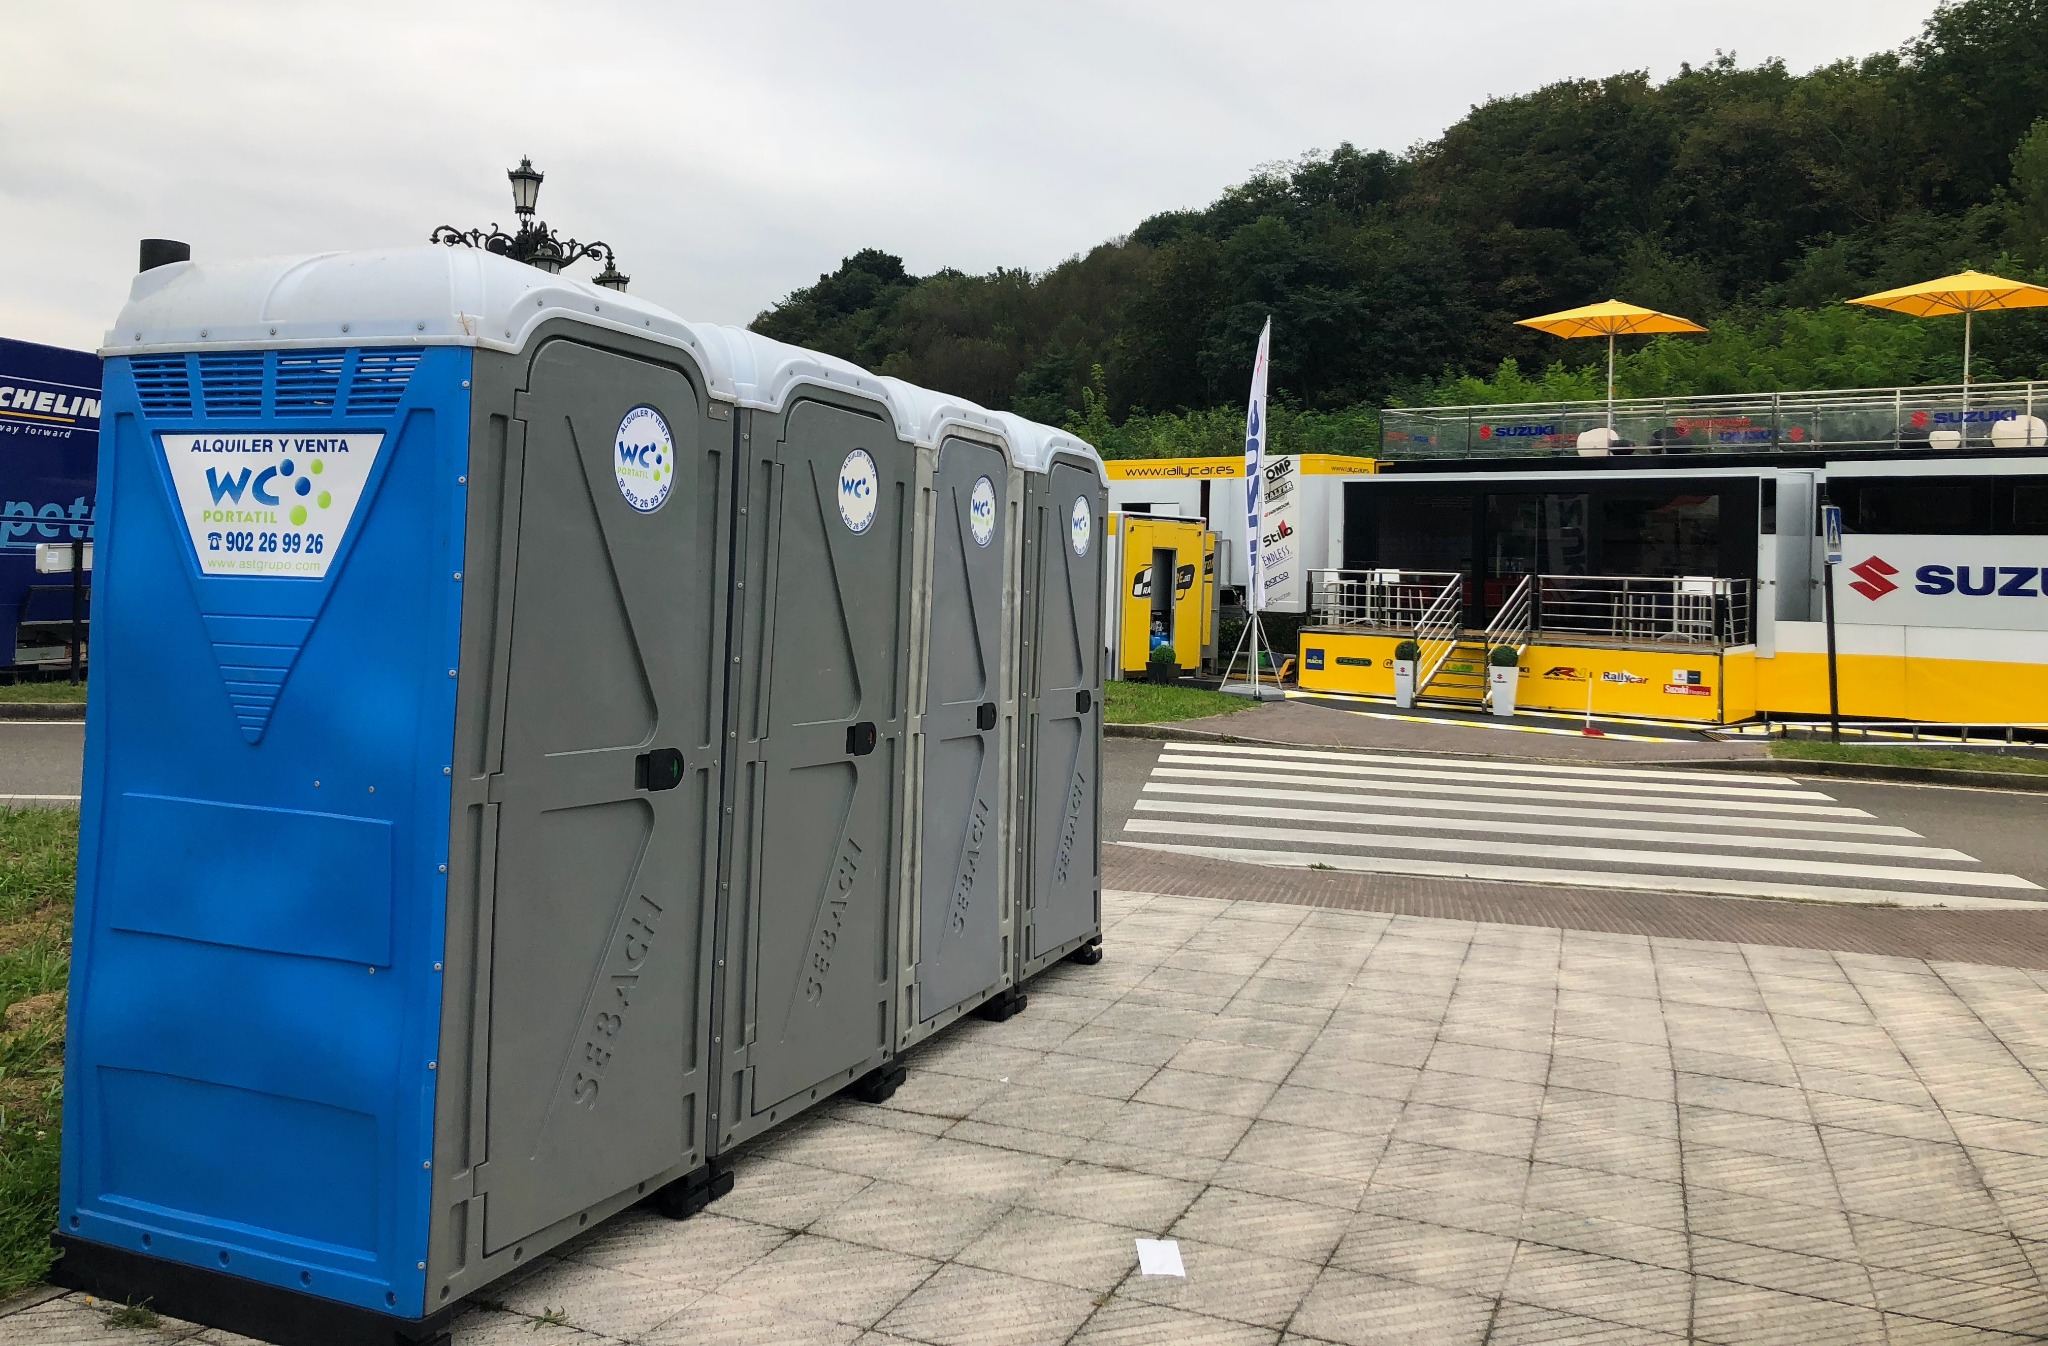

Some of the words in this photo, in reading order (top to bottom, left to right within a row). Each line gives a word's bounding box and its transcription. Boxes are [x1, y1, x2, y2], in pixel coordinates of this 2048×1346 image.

[620, 410, 649, 434] ALQUILER
[650, 411, 655, 419] Y
[655, 416, 670, 443] VENTA
[1933, 409, 2017, 424] SUZUKI
[25, 425, 72, 439] forward
[1494, 425, 1556, 437] SUZUKI
[191, 439, 273, 453] ALQUILER
[280, 439, 290, 452] Y
[294, 439, 349, 453] VENTA
[618, 440, 650, 469] WC
[616, 466, 649, 479] PORTATIL
[1125, 464, 1235, 478] www.rallycar.es
[1265, 459, 1291, 480] OMP
[205, 464, 280, 507] WC
[841, 475, 862, 499] WC
[625, 488, 638, 506] 902
[639, 499, 649, 508] 26
[650, 495, 659, 507] 99
[972, 499, 985, 518] WC
[203, 509, 278, 524] PORTATIL
[226, 531, 254, 552] 902
[258, 532, 277, 553] 26
[282, 532, 302, 554] 99
[305, 533, 324, 555] 26
[1262, 523, 1293, 548] Stilo
[207, 559, 320, 572] www.astgrupo.com
[1262, 545, 1290, 567] ENDLESS
[1142, 585, 1151, 595] RA
[1914, 565, 2048, 598] SUZ
[1057, 772, 1086, 889] SEBACH
[952, 798, 989, 939] SEBACH
[806, 837, 863, 1009] SEBACH
[574, 894, 663, 1112] SEBACH
